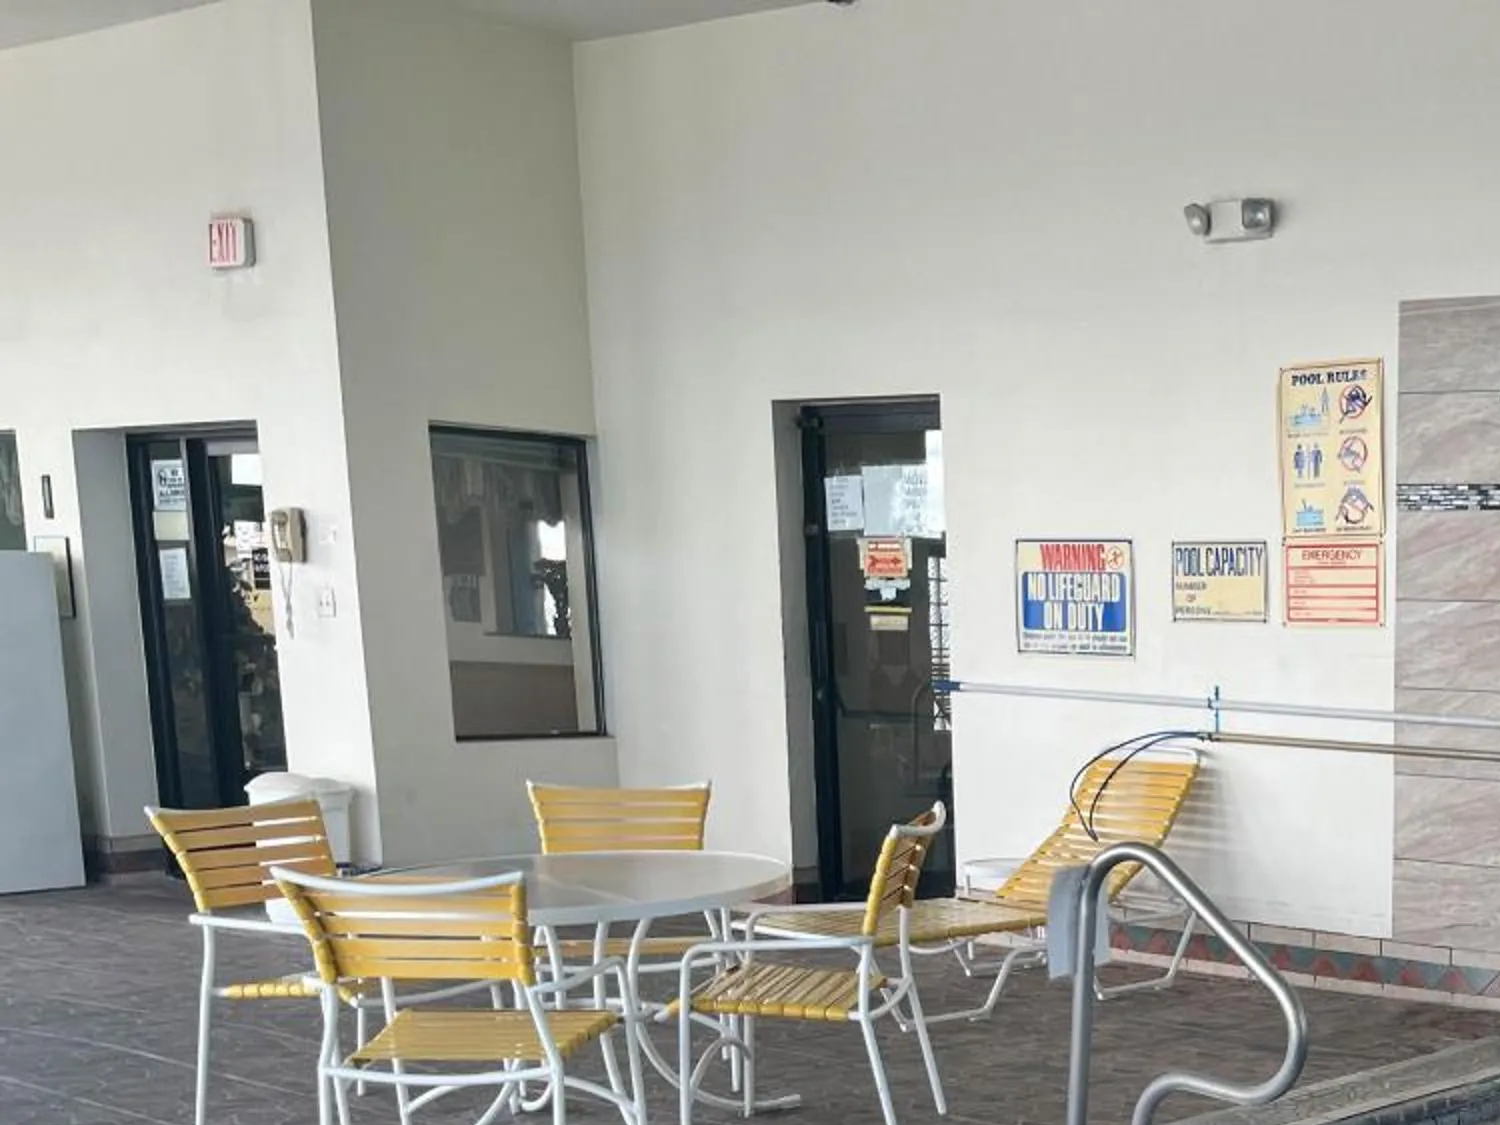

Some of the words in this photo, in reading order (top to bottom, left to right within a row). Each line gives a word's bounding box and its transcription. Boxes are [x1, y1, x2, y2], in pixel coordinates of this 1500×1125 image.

[208, 222, 237, 263] EXIT
[1291, 373, 1325, 387] POOL
[1326, 369, 1367, 384] RULES
[1040, 543, 1106, 572] WARNING
[1175, 547, 1204, 576] POOL
[1205, 547, 1263, 576] CAPACITY
[1301, 549, 1361, 561] EMERGENCY
[1027, 572, 1046, 602] NO
[1048, 572, 1121, 603] LIFEGUARD
[1043, 600, 1063, 630] ON
[1067, 601, 1104, 631] DUTY
